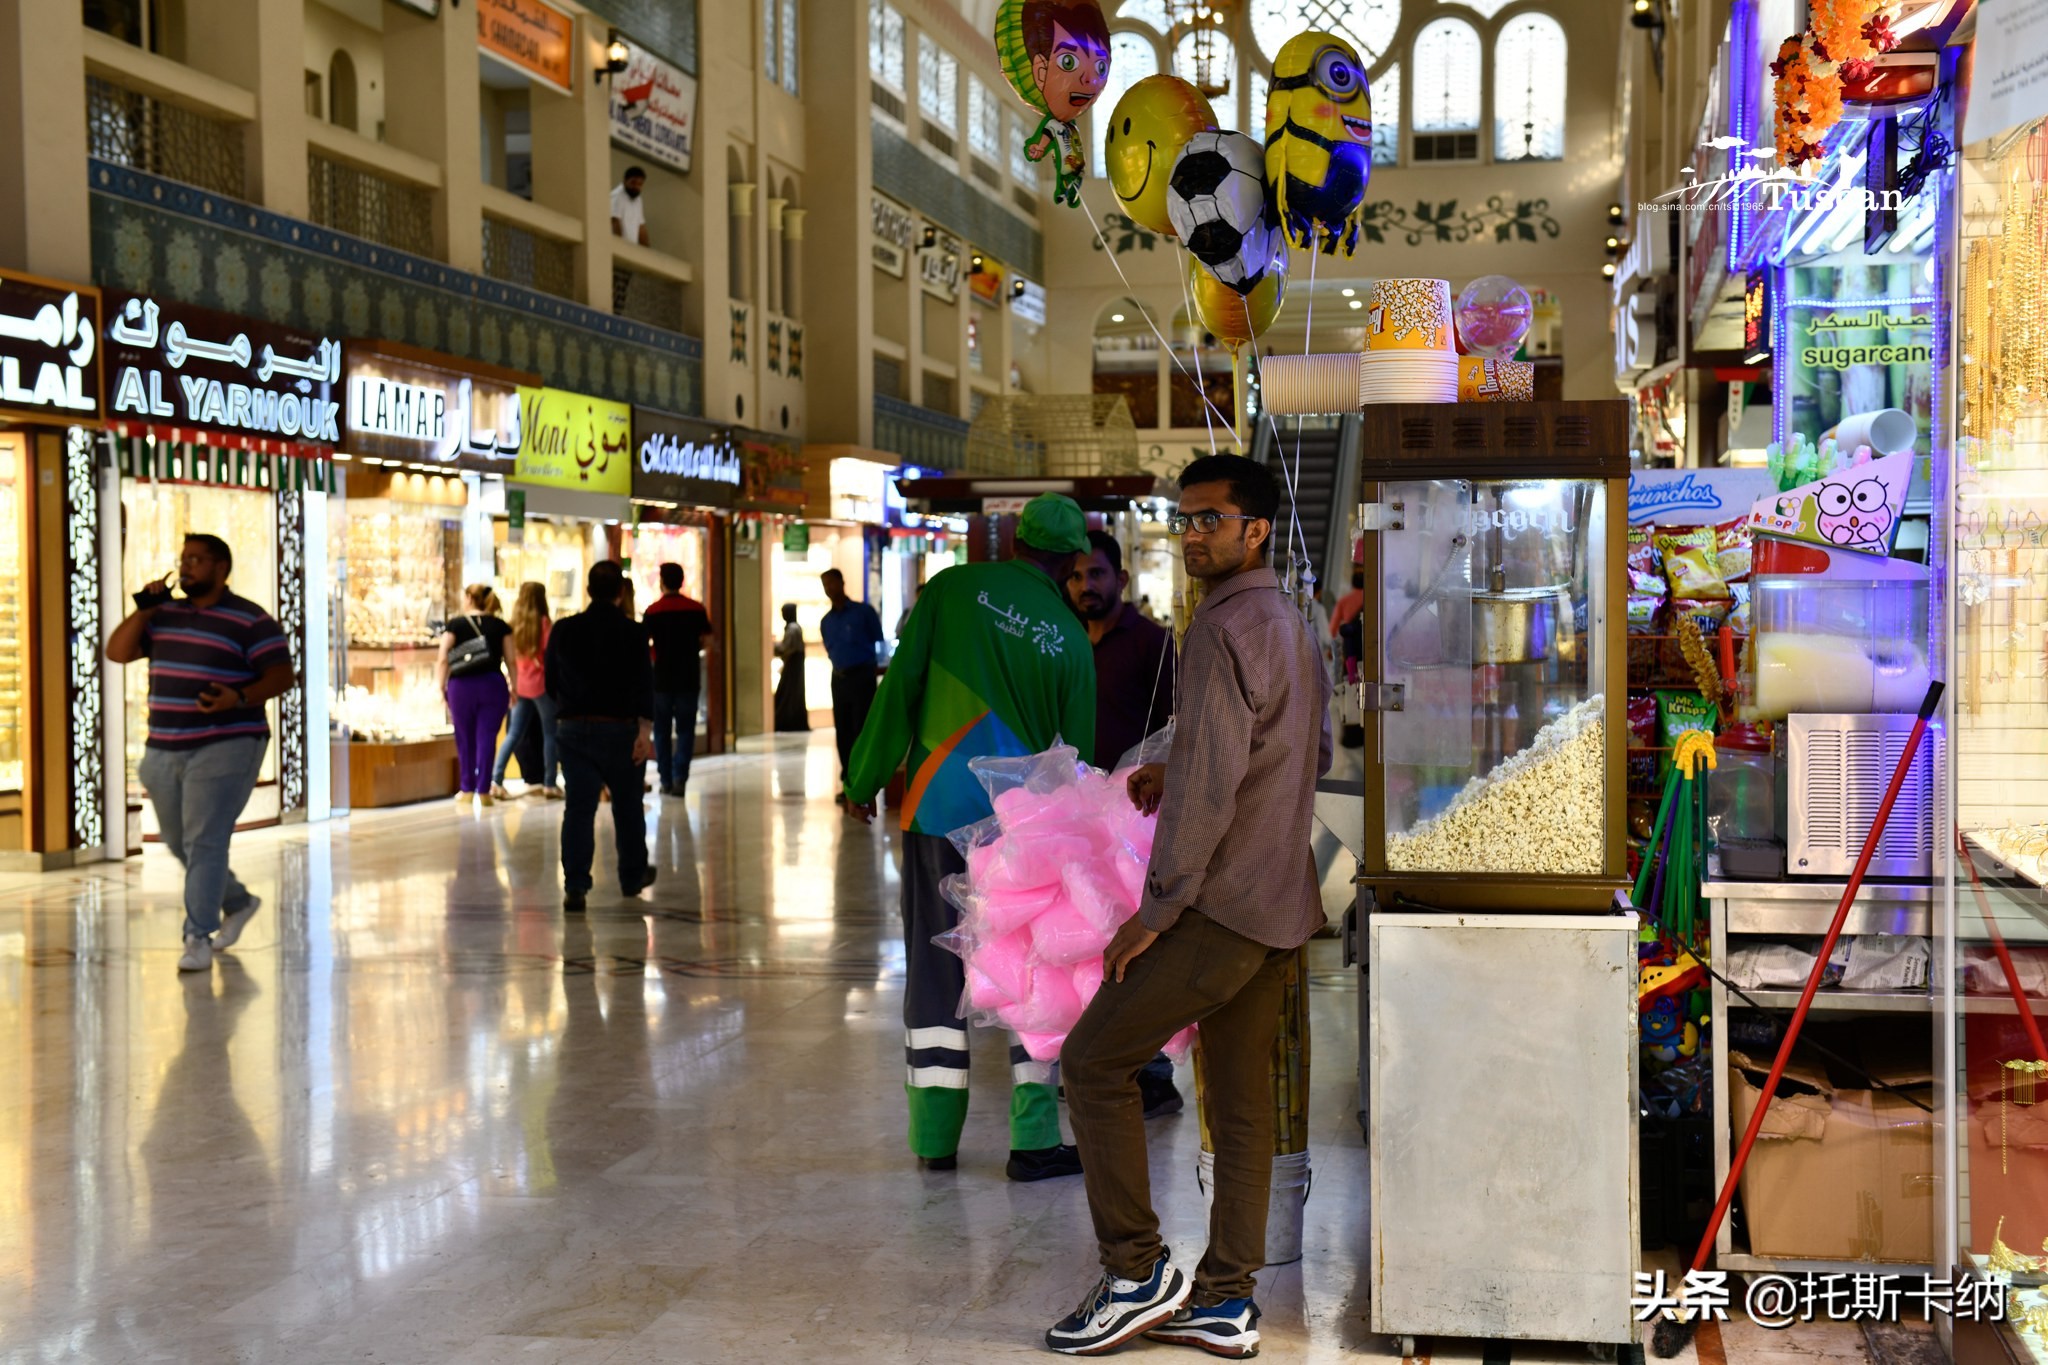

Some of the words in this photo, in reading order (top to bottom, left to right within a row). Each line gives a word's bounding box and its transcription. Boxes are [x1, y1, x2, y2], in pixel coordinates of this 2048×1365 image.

[1884, 315, 1933, 331] صب
[0, 355, 97, 412] LAL
[114, 365, 175, 417] AL
[179, 374, 341, 443] YARMOUK
[362, 381, 445, 438] LAMAR
[1628, 473, 1722, 514] runchos
[1668, 702, 1708, 717] Krisps
